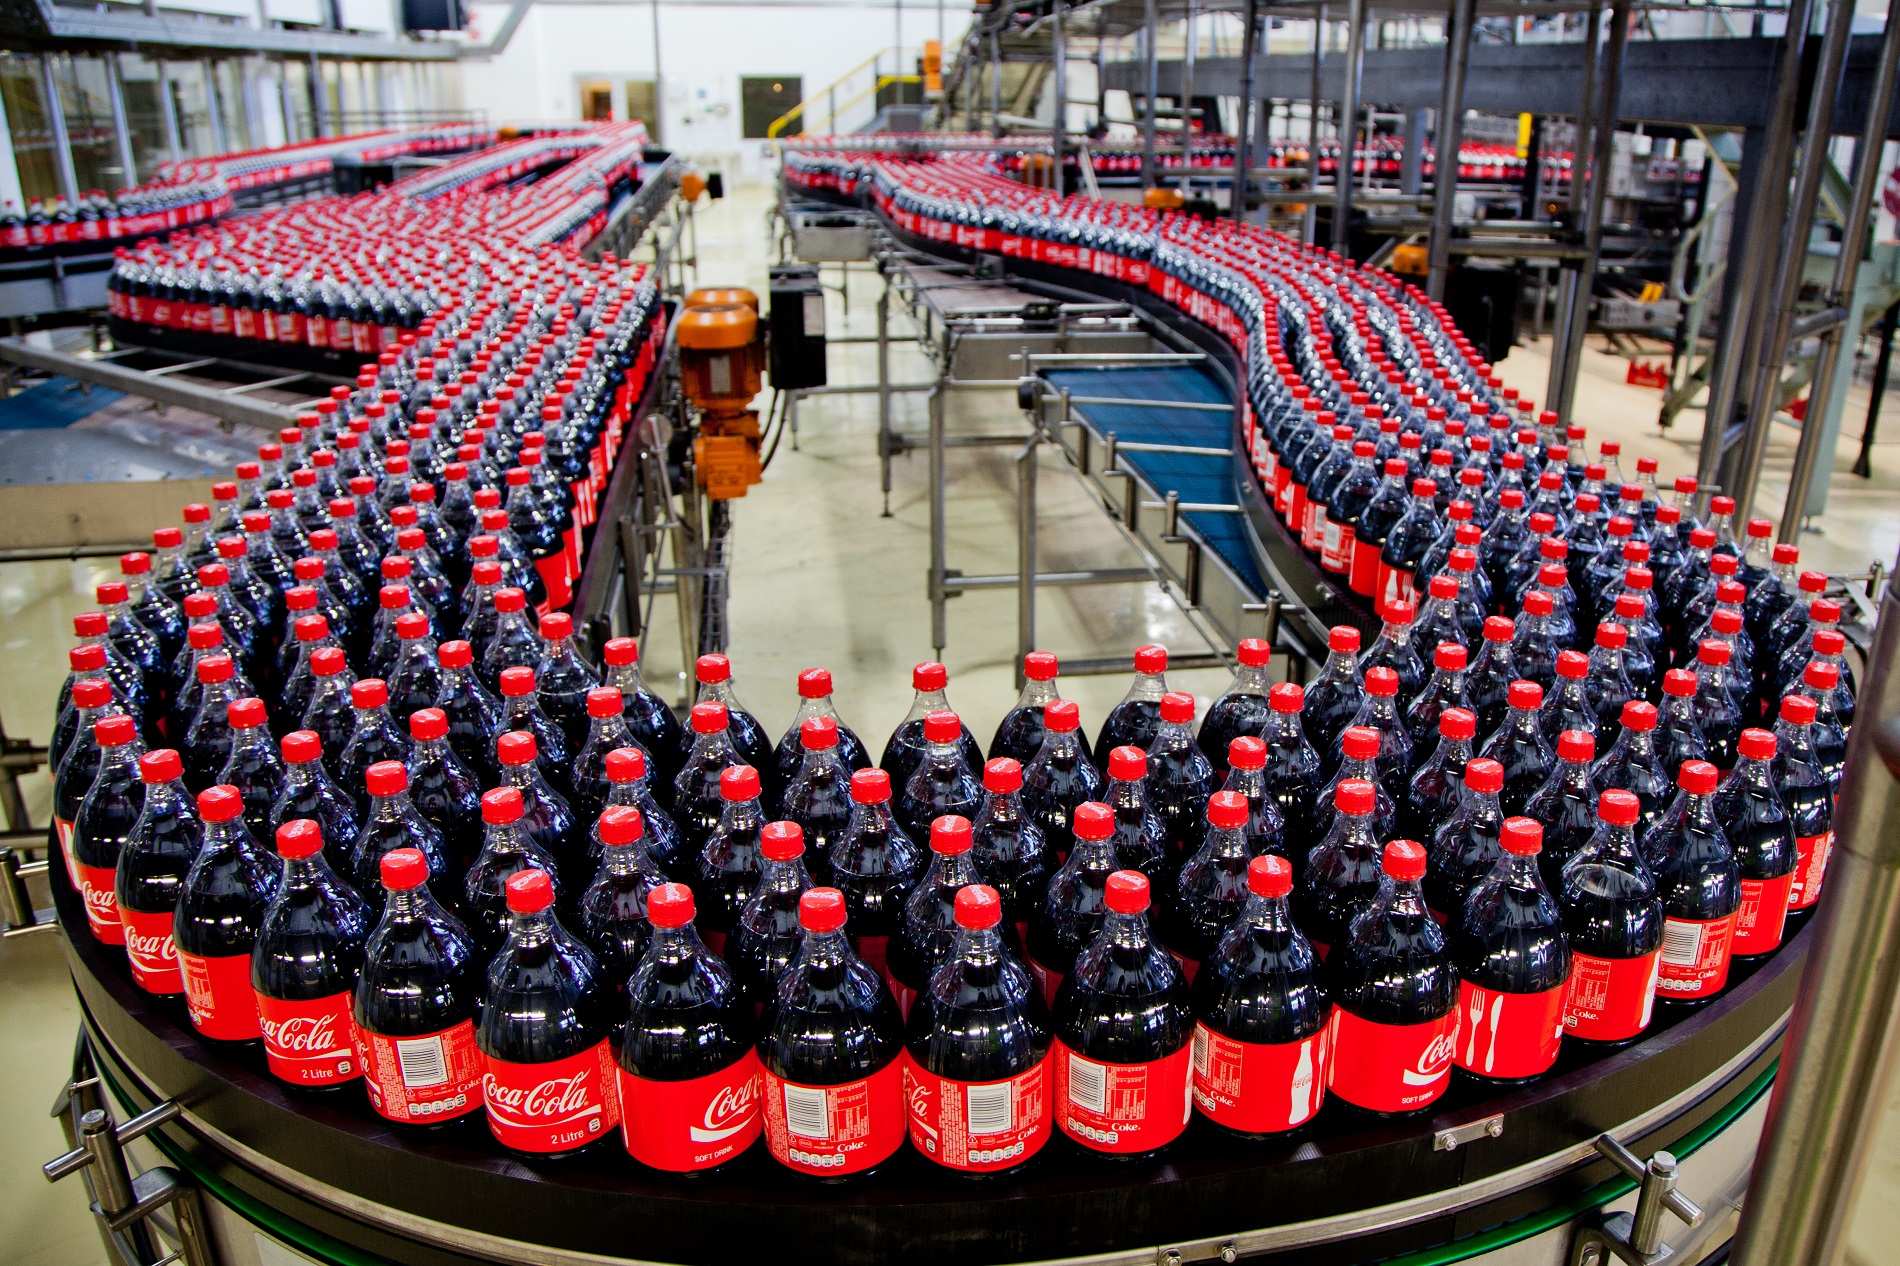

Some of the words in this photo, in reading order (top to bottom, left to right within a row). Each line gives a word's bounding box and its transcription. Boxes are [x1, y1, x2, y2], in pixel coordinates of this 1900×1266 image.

[1735, 929, 1748, 937] oke
[1698, 970, 1715, 979] Coke
[1572, 1008, 1597, 1020] Coke
[260, 1013, 338, 1050] ca-Cola
[301, 1069, 308, 1079] 2
[310, 1068, 333, 1079] Litre
[482, 1068, 591, 1116] Coca-Cola
[1210, 1090, 1234, 1106] Coke
[1402, 1096, 1418, 1104] SOFT
[1419, 1090, 1434, 1101] DRINK
[1017, 1124, 1038, 1141] Coke
[1111, 1122, 1138, 1132] Coke
[551, 1134, 558, 1145] 2
[560, 1129, 584, 1144] Litre
[695, 1153, 713, 1163] SOFT
[714, 1145, 733, 1158] DRINK
[837, 1141, 864, 1153] Coke
